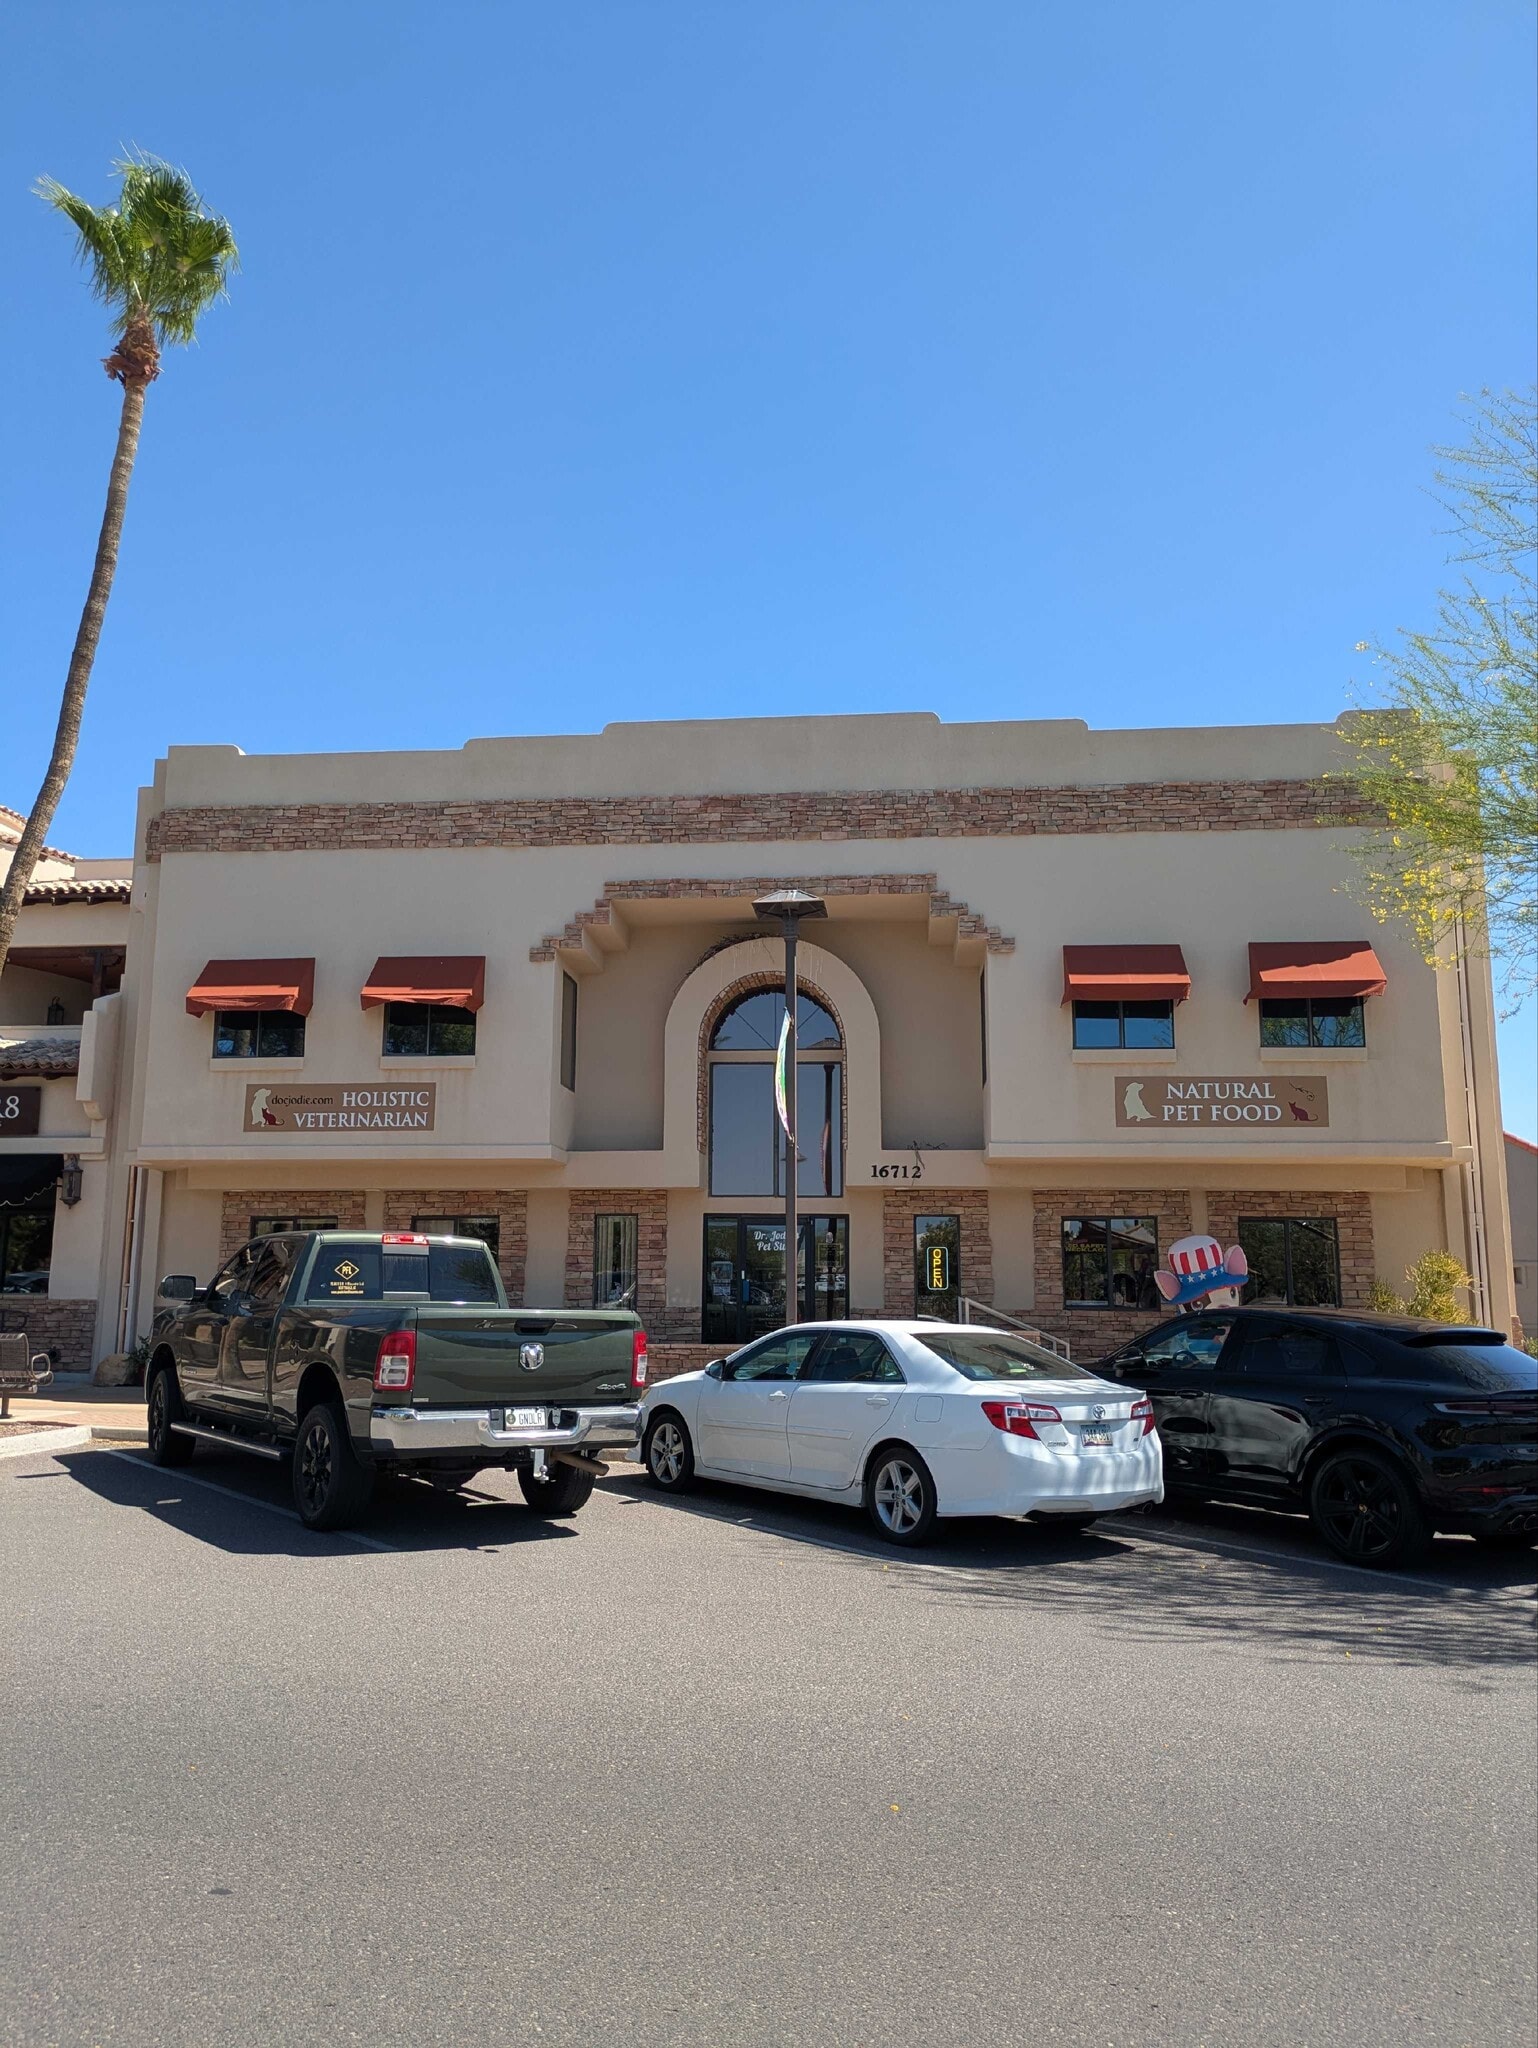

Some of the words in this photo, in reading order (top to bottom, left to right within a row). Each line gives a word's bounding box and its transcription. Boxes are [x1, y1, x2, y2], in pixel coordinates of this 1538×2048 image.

[1166, 1082, 1276, 1099] NATURAL
[271, 1094, 333, 1107] docjodie.com
[342, 1091, 429, 1107] HOLISTIC
[293, 1111, 428, 1128] VETERINARIAN
[1162, 1104, 1204, 1121] PET
[1210, 1104, 1282, 1121] FOOD
[871, 1164, 922, 1179] 16712
[753, 1230, 768, 1240] Dr.
[756, 1241, 772, 1252] Pet
[932, 1248, 943, 1288] OPEN
